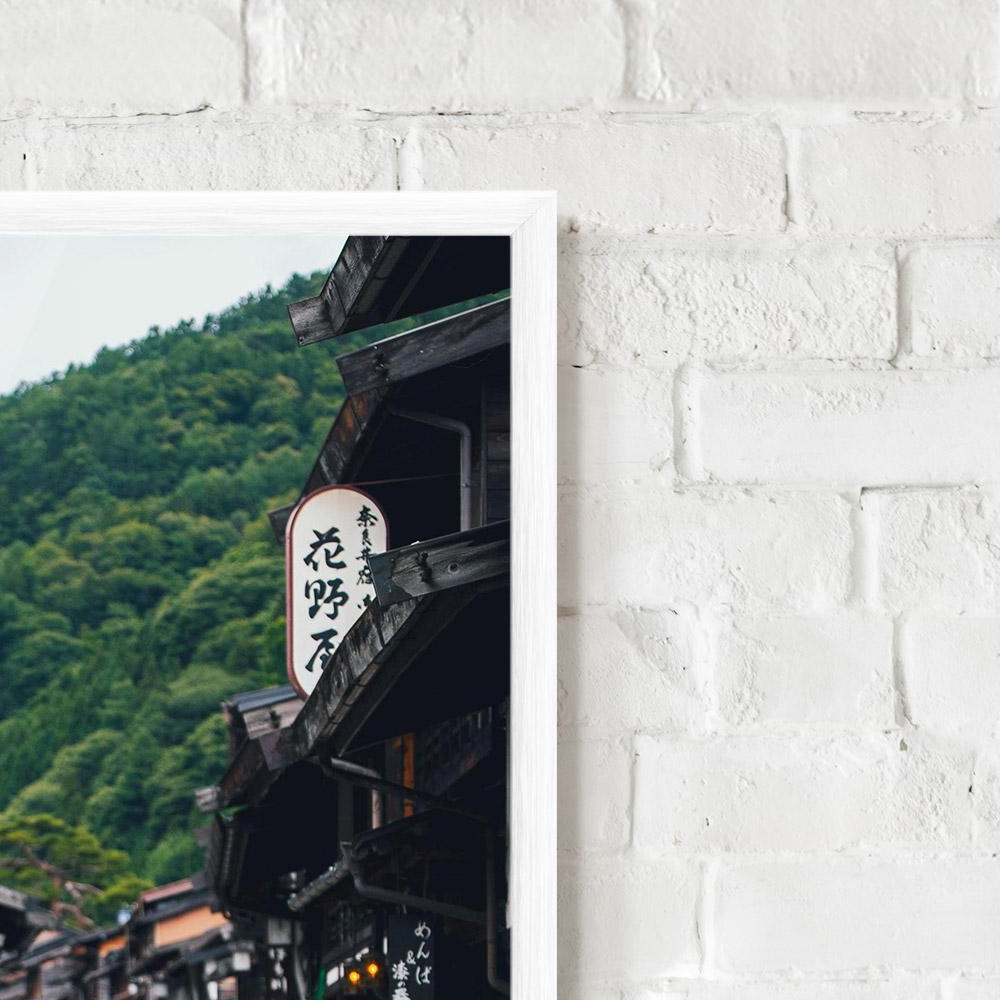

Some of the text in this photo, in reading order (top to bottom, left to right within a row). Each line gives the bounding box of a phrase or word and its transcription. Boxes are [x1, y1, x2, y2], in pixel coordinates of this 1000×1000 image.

[303, 526, 350, 673] 花野屋
[356, 504, 379, 610] 奈良井宿
[406, 950, 417, 966] &
